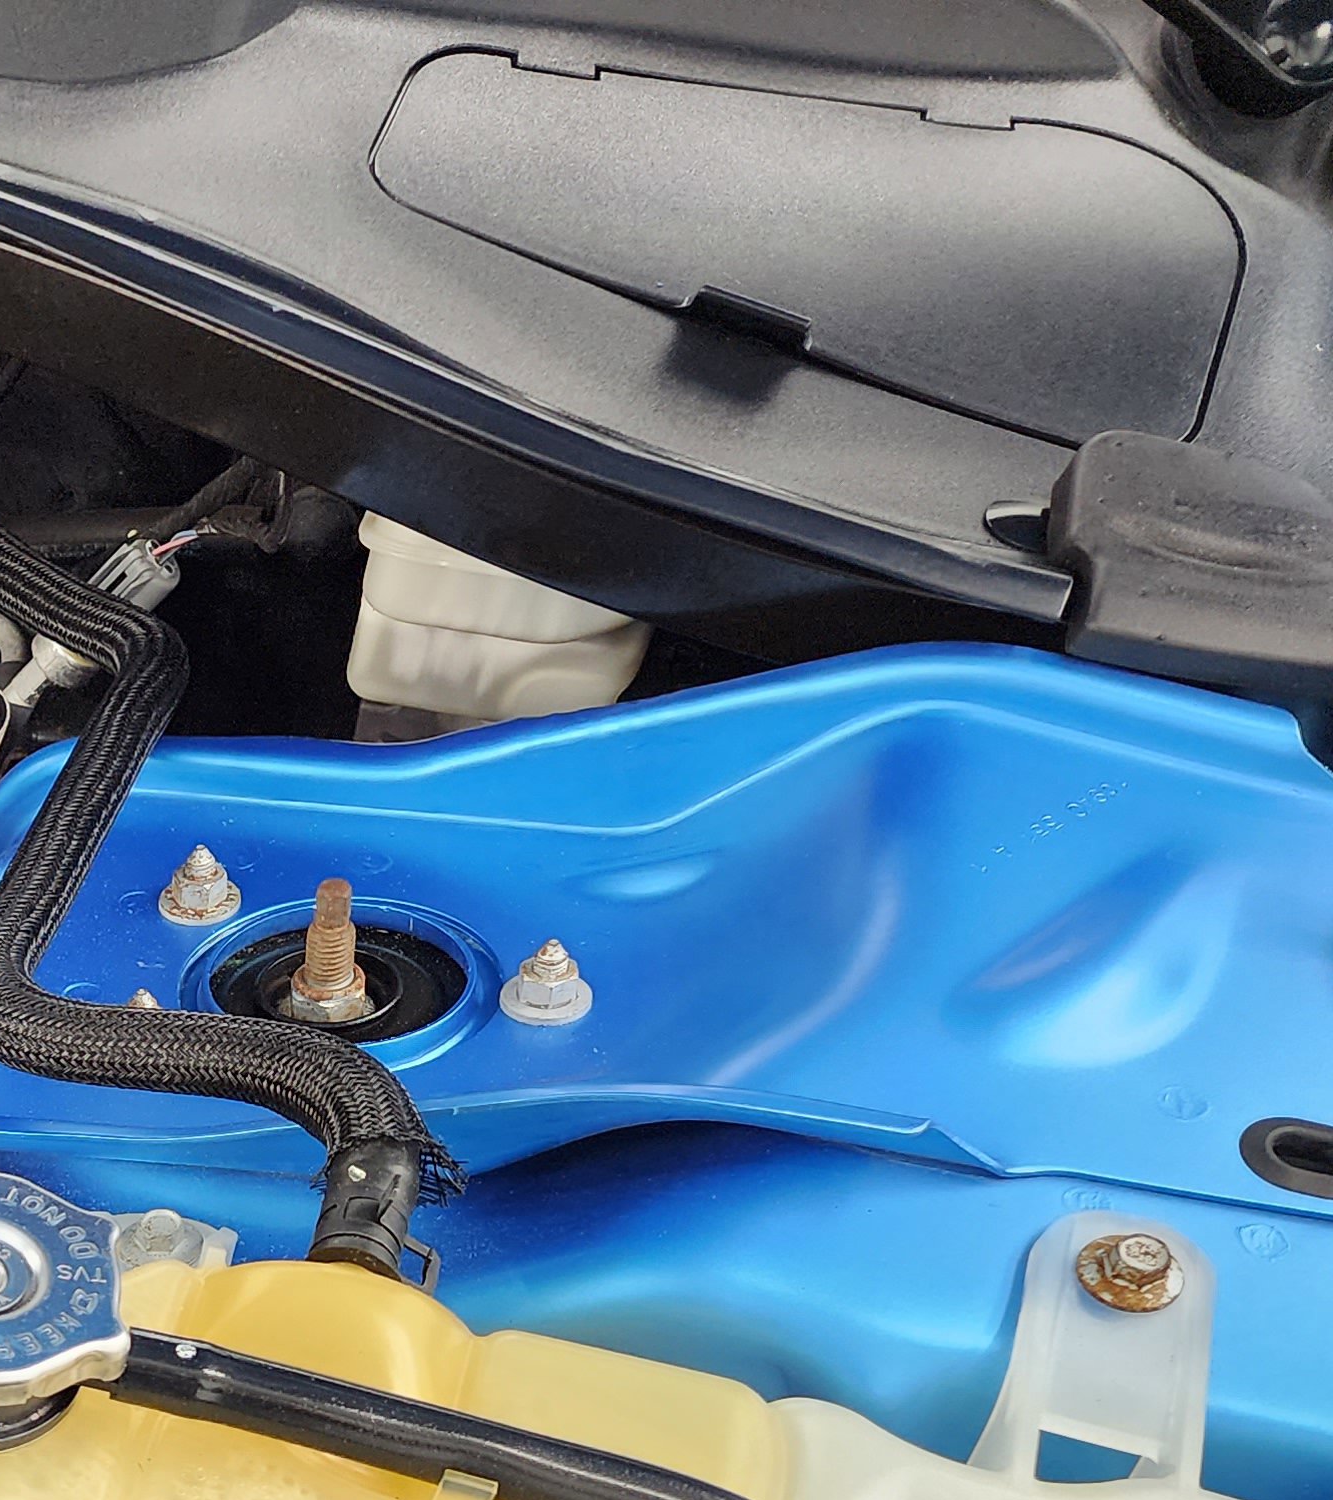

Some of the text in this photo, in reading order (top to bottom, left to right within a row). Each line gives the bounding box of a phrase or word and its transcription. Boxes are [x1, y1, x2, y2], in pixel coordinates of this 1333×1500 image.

[0, 1187, 68, 1226] NOT
[58, 1225, 102, 1260] DO
[55, 1263, 108, 1284] TVS
